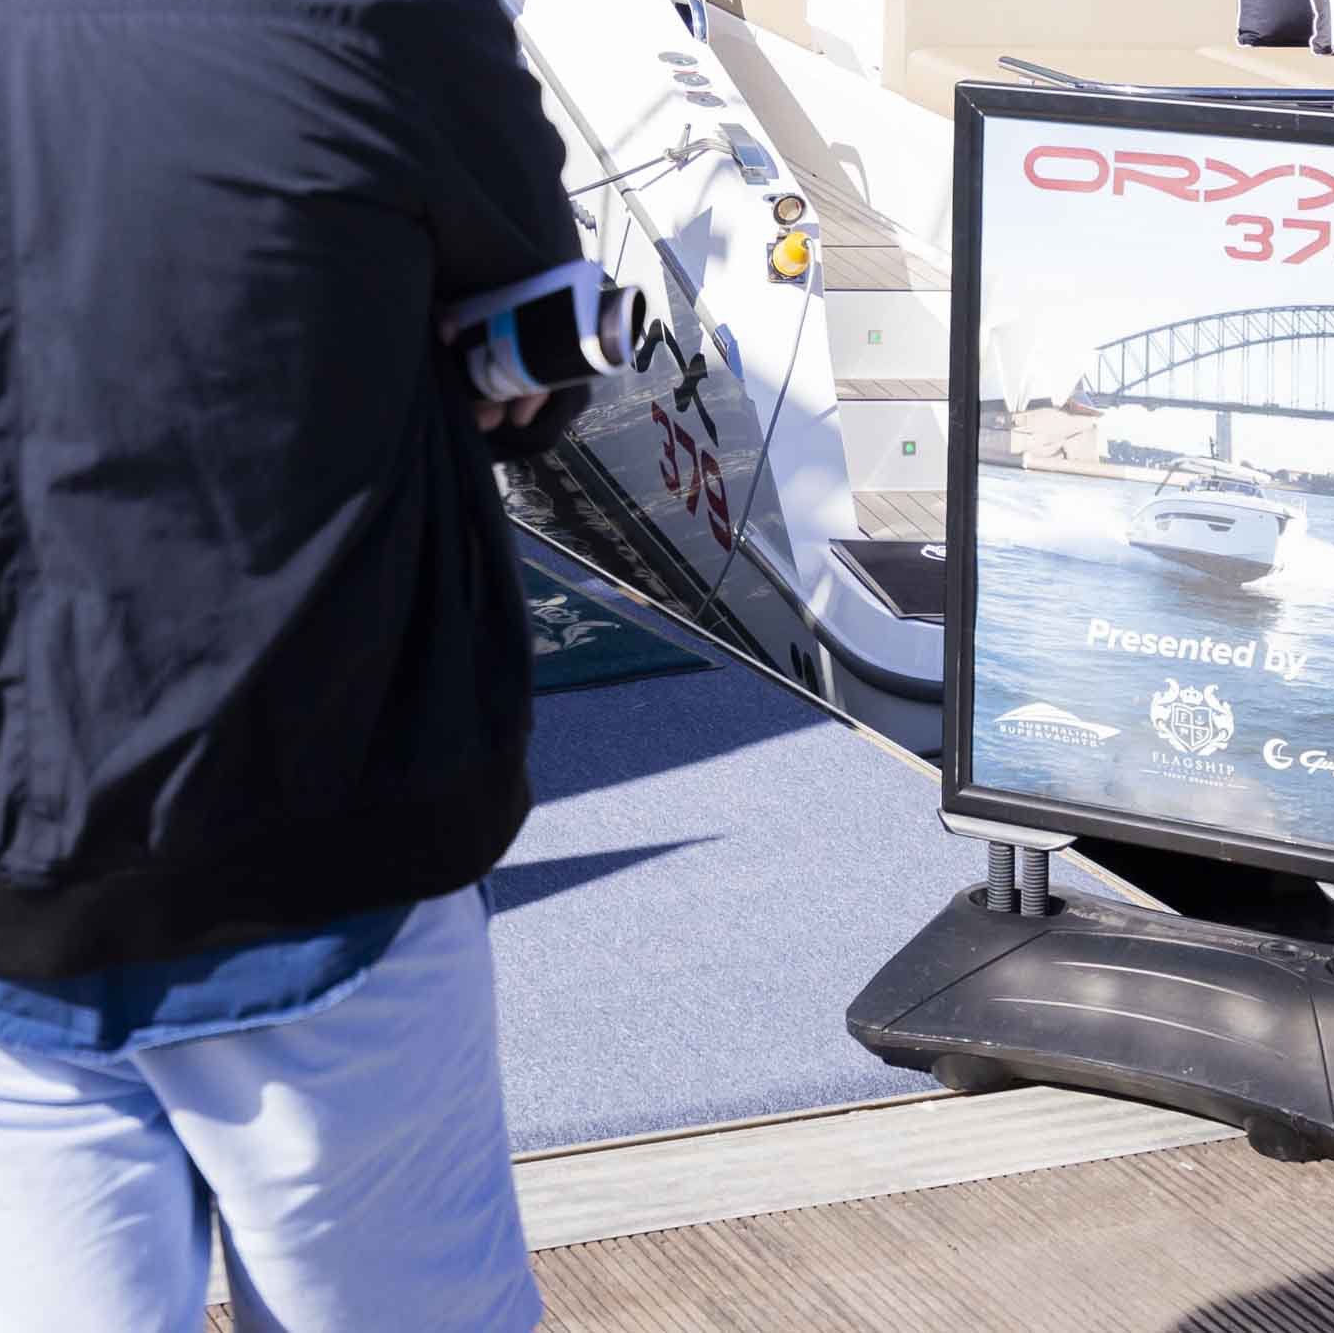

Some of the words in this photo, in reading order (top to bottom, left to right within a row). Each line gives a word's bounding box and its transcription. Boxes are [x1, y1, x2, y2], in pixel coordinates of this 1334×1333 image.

[1087, 618, 1257, 669] Presented
[1262, 631, 1308, 681] by
[1018, 721, 1098, 739] AUSTRALIAN
[1151, 751, 1235, 775] FLAGSHIP
